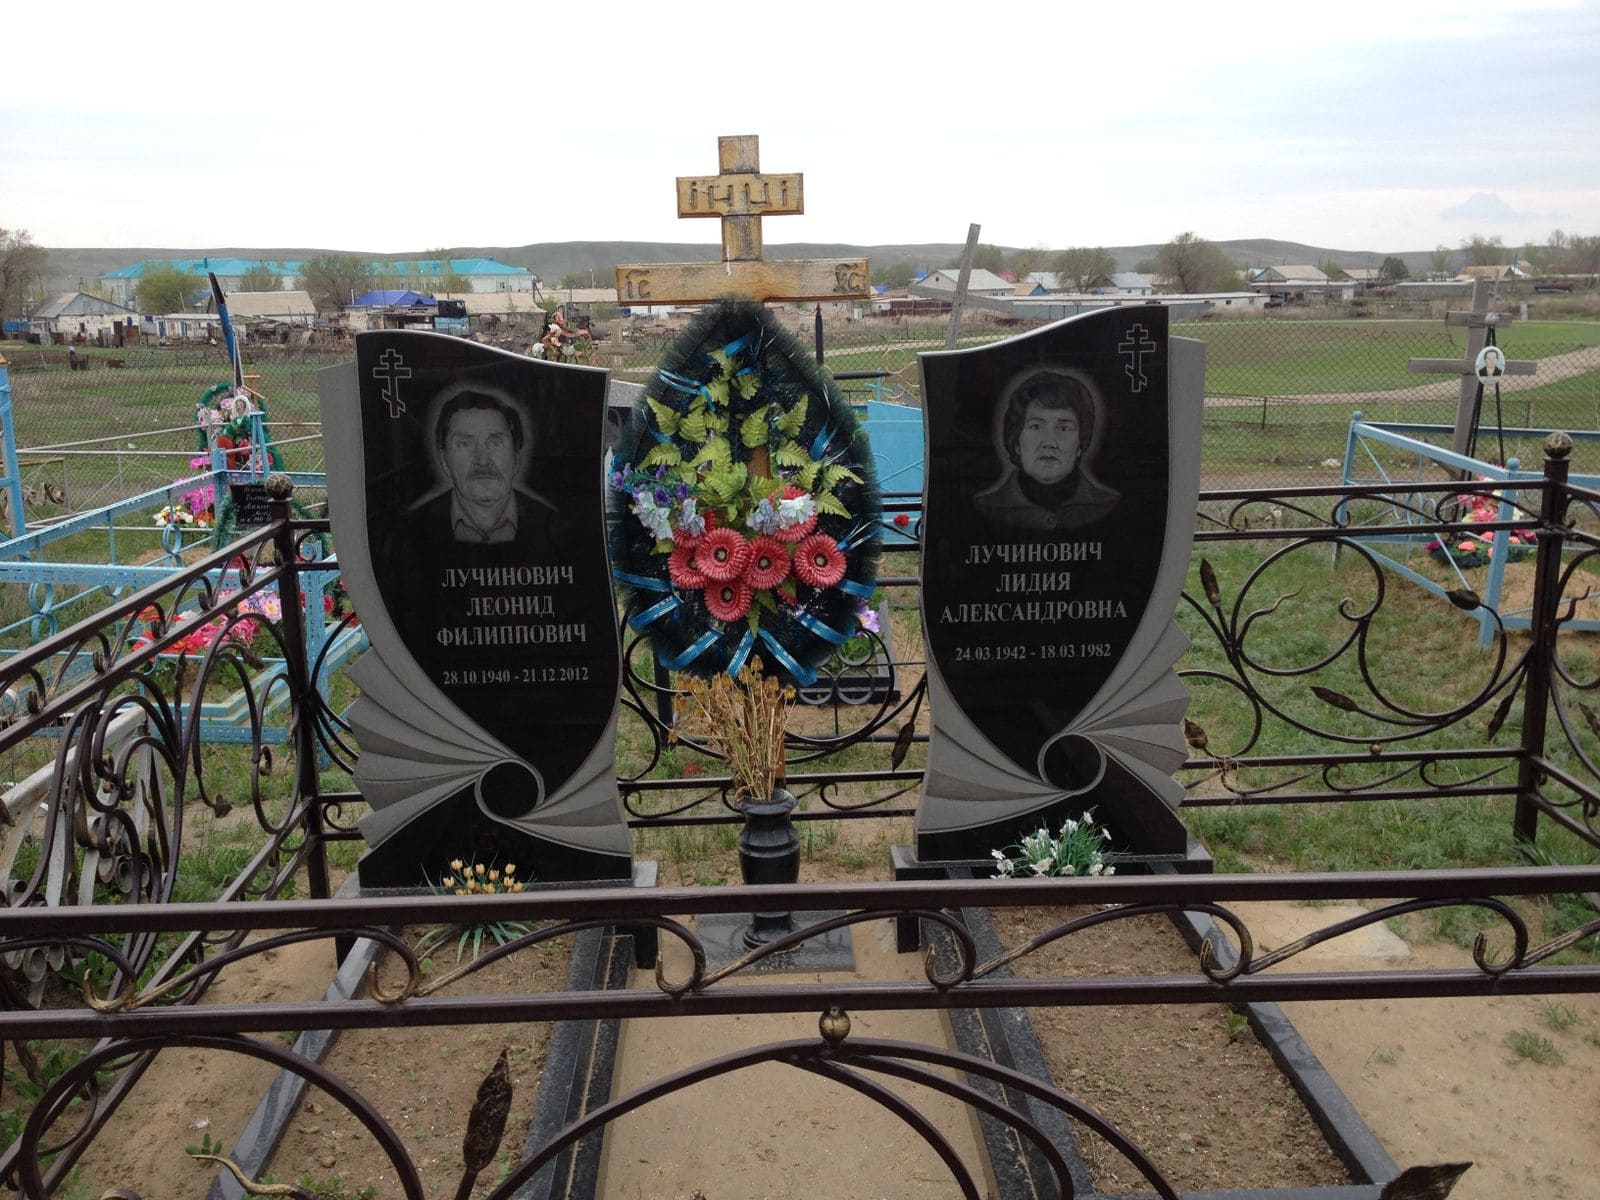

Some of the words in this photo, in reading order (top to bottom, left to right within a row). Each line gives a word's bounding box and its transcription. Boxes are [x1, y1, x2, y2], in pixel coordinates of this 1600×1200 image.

[965, 541, 1102, 564] ЛУЧИНОВИЧ
[442, 565, 574, 588] ЛУЧИНОВИЧ
[995, 571, 1071, 596] ЛИДИЯ
[466, 595, 555, 618] ЛЕОНИД
[939, 599, 1128, 625] АЛЕКСАНДРОВНА
[436, 623, 587, 646] ФИЛИППОВИЧ
[955, 645, 1027, 661] 24.03.1942
[1040, 643, 1112, 659] 18.03.1982
[443, 669, 511, 685] 28.10.1940
[522, 667, 589, 682] 21.12.2012
